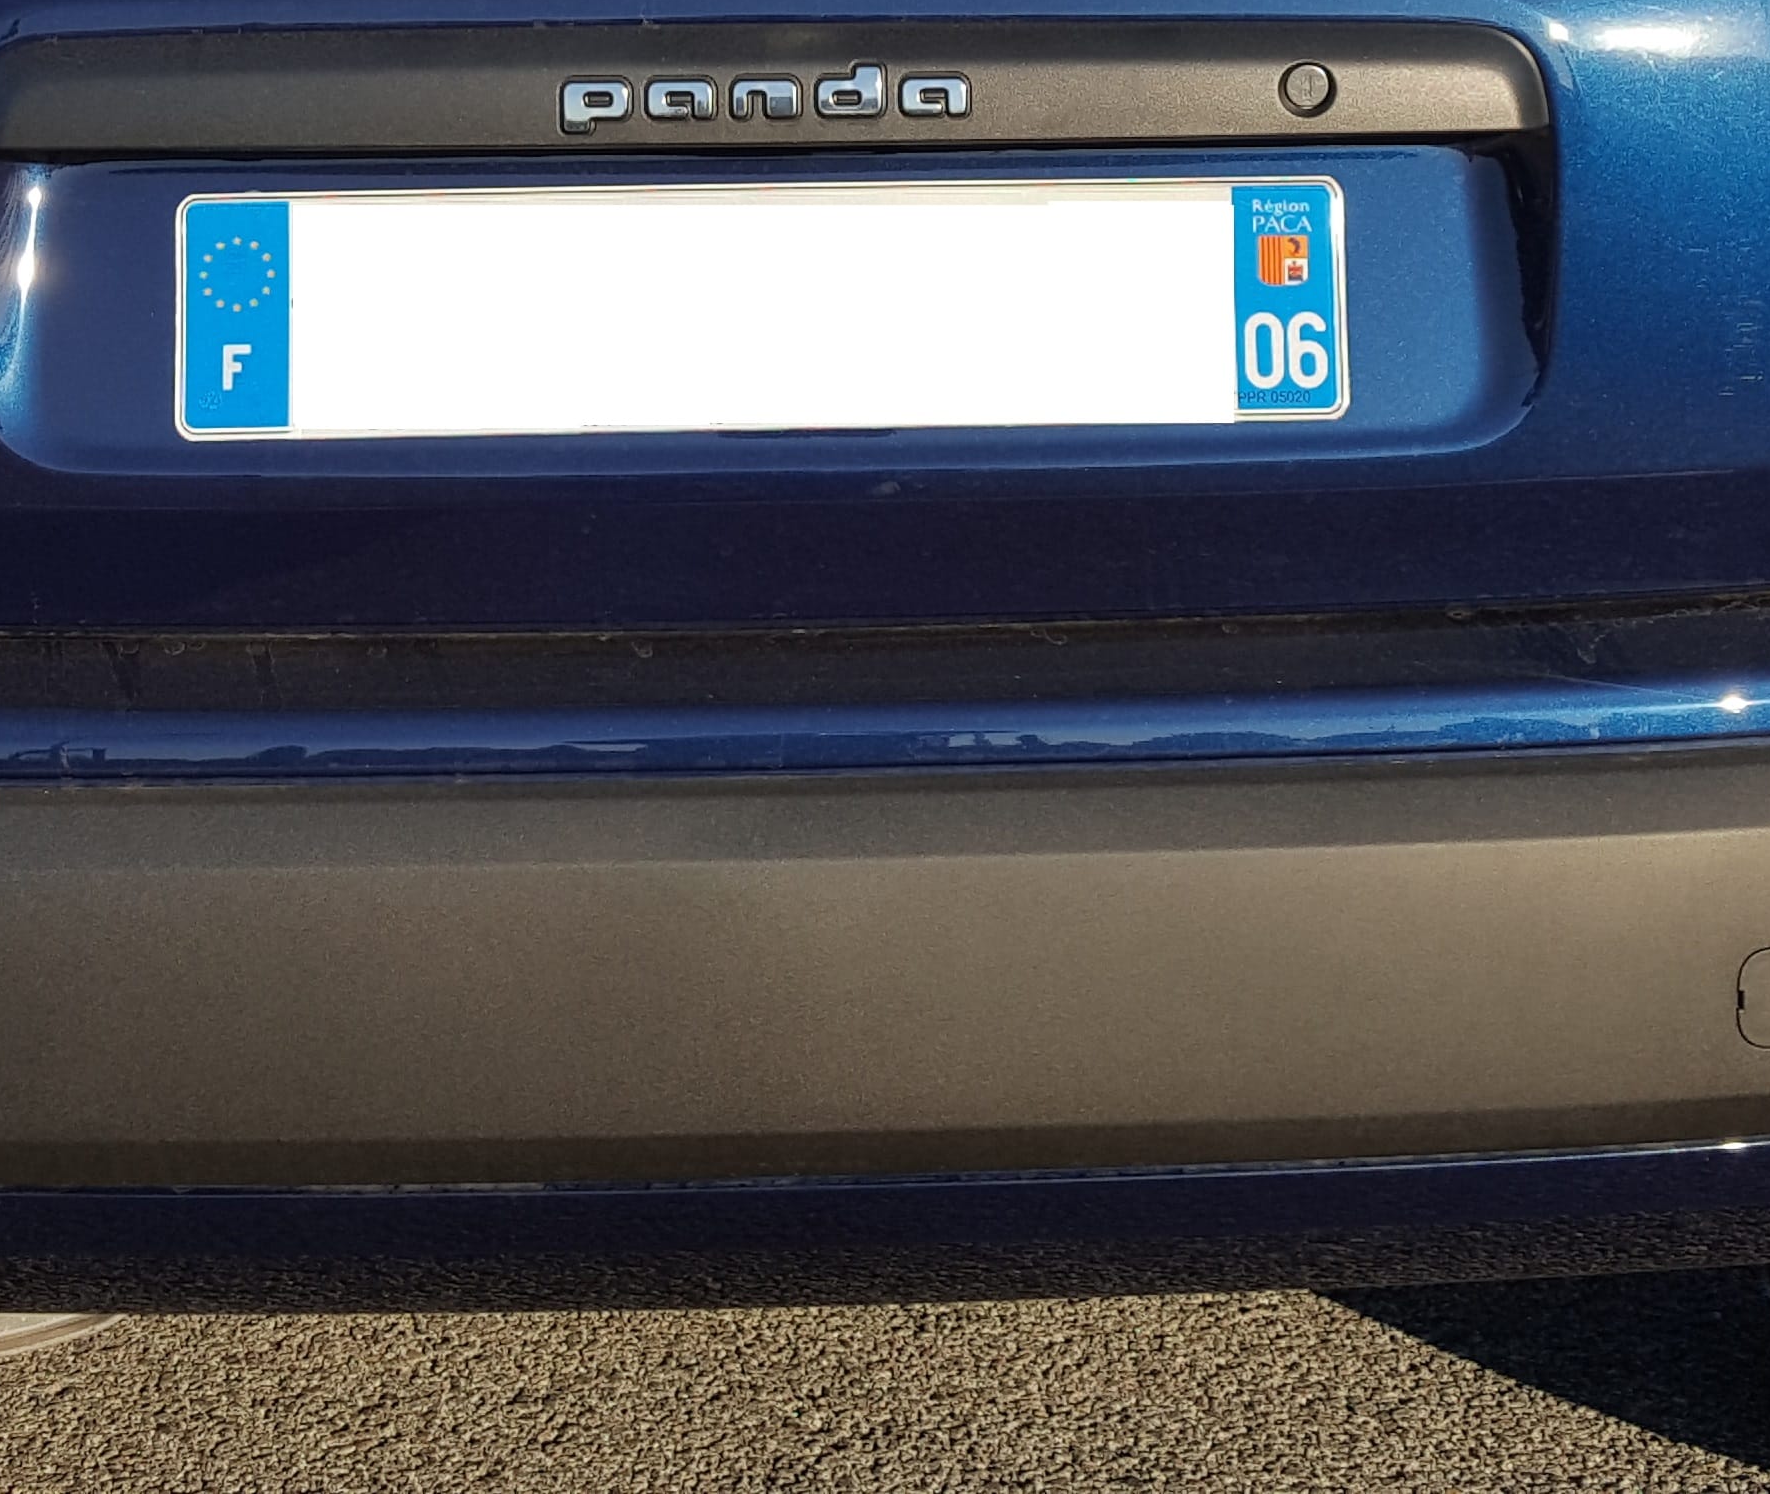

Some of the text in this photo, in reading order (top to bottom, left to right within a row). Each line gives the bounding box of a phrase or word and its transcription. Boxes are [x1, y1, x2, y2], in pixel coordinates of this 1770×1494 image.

[560, 61, 971, 134] panda
[1252, 199, 1310, 216] Région
[1252, 215, 1312, 233] PACA
[222, 343, 252, 391] F
[1244, 311, 1329, 389] 06
